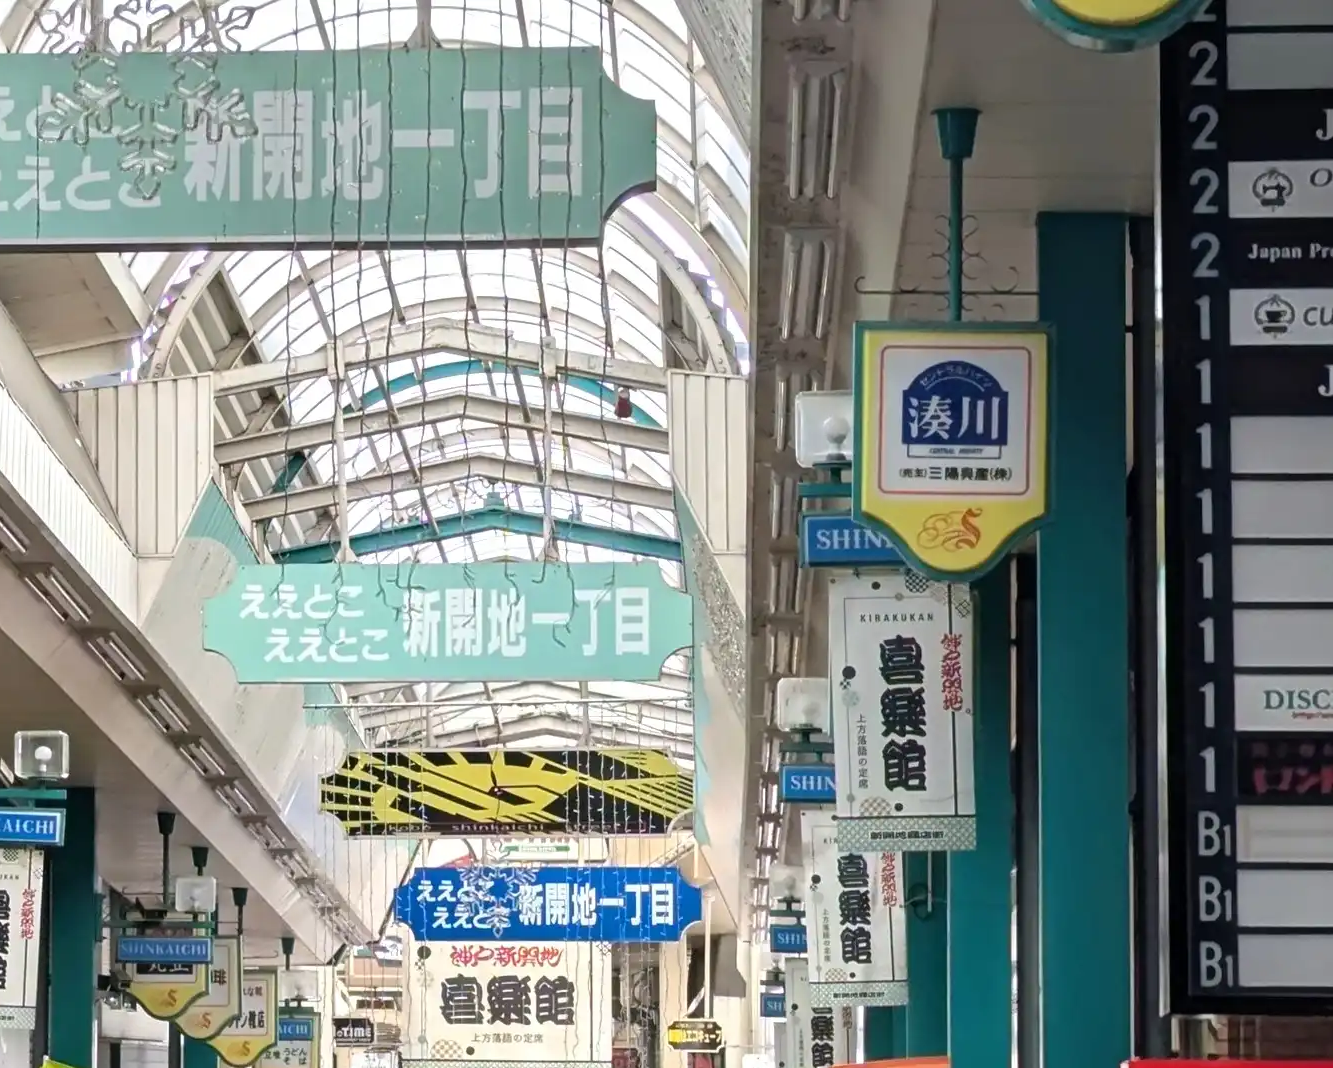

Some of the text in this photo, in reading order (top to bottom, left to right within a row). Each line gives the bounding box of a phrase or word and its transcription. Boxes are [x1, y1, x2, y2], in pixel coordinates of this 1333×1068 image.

[1189, 41, 1218, 86] 2
[183, 85, 584, 200] 新開地一丁目
[1188, 105, 1219, 150] 2
[1189, 168, 1220, 214] 2
[1191, 232, 1220, 278] 2
[1248, 243, 1302, 262] Japan
[1195, 295, 1211, 340] 1
[1195, 359, 1212, 404] 1
[908, 395, 1000, 440] 湊川
[1196, 423, 1212, 469] 1
[1196, 488, 1213, 534] 1
[816, 528, 889, 552] SHIN
[1197, 552, 1214, 599] 1
[238, 584, 364, 620] ええとこ
[402, 587, 651, 658] 新開地一丁目
[860, 613, 934, 623] KIRAKUKAN
[264, 628, 390, 663] ええとこ
[1198, 617, 1214, 663] 1
[1198, 682, 1215, 728] 1
[791, 775, 836, 790] SHIN
[1199, 746, 1216, 793] 1
[1198, 810, 1232, 857] B1
[519, 883, 673, 927] 新開地一丁目
[1199, 876, 1233, 921] B1
[1199, 940, 1234, 987] B1
